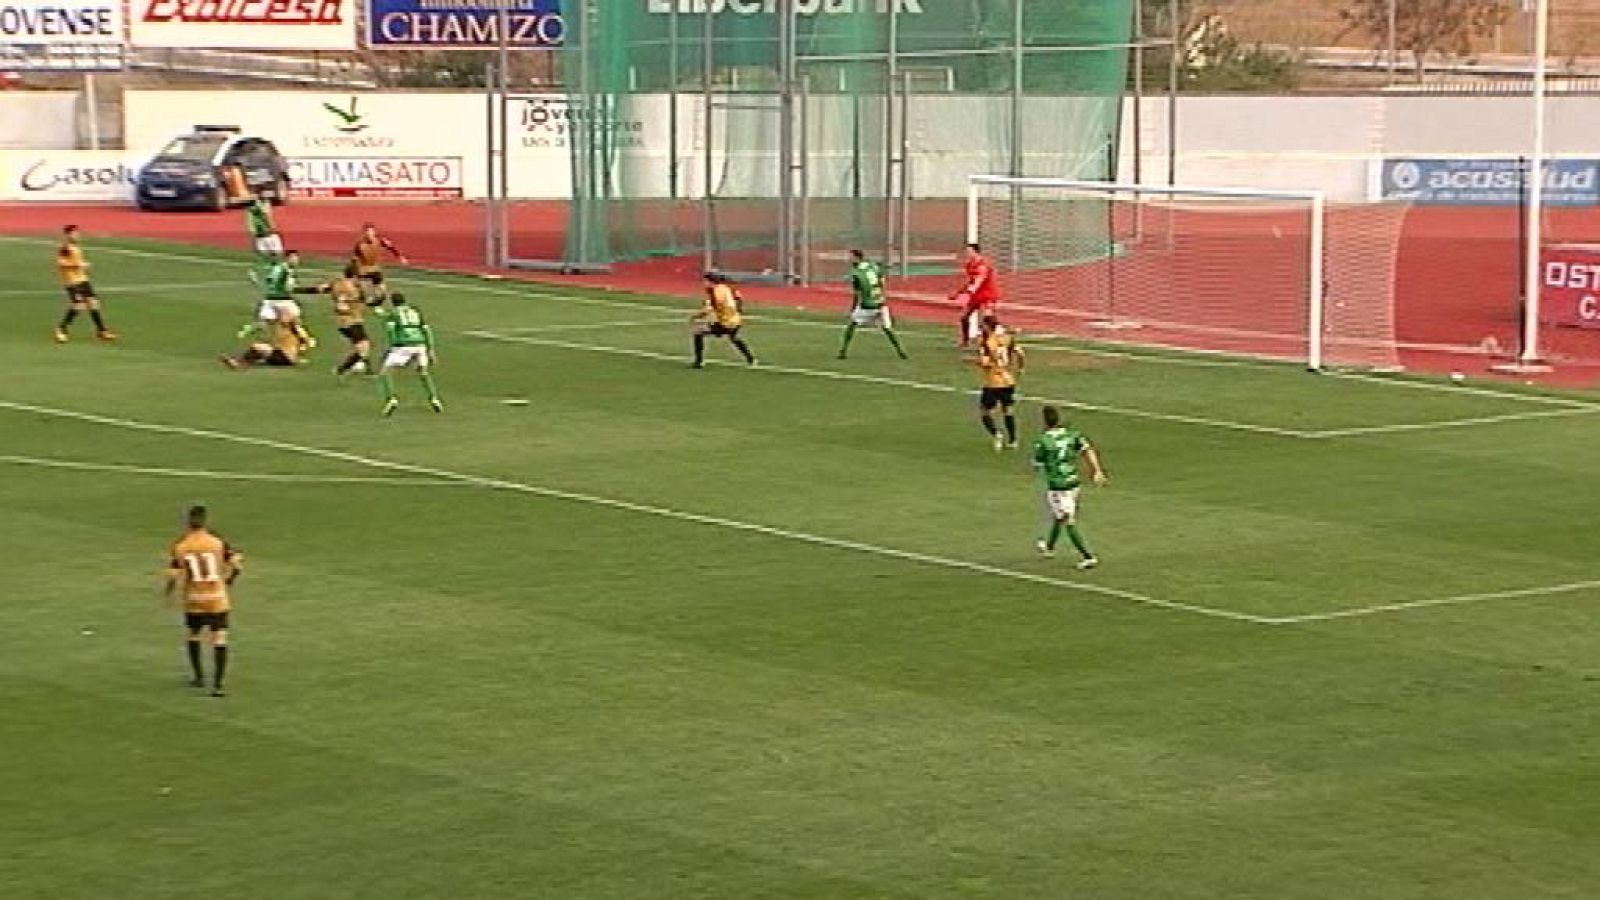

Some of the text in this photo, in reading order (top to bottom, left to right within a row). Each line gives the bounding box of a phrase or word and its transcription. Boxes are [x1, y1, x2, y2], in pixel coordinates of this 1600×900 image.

[1, 8, 113, 36] OVENSE
[288, 162, 451, 185] CLIMASATO
[1580, 296, 1600, 320] C
[1056, 438, 1069, 460] 7
[185, 552, 220, 582] 11
